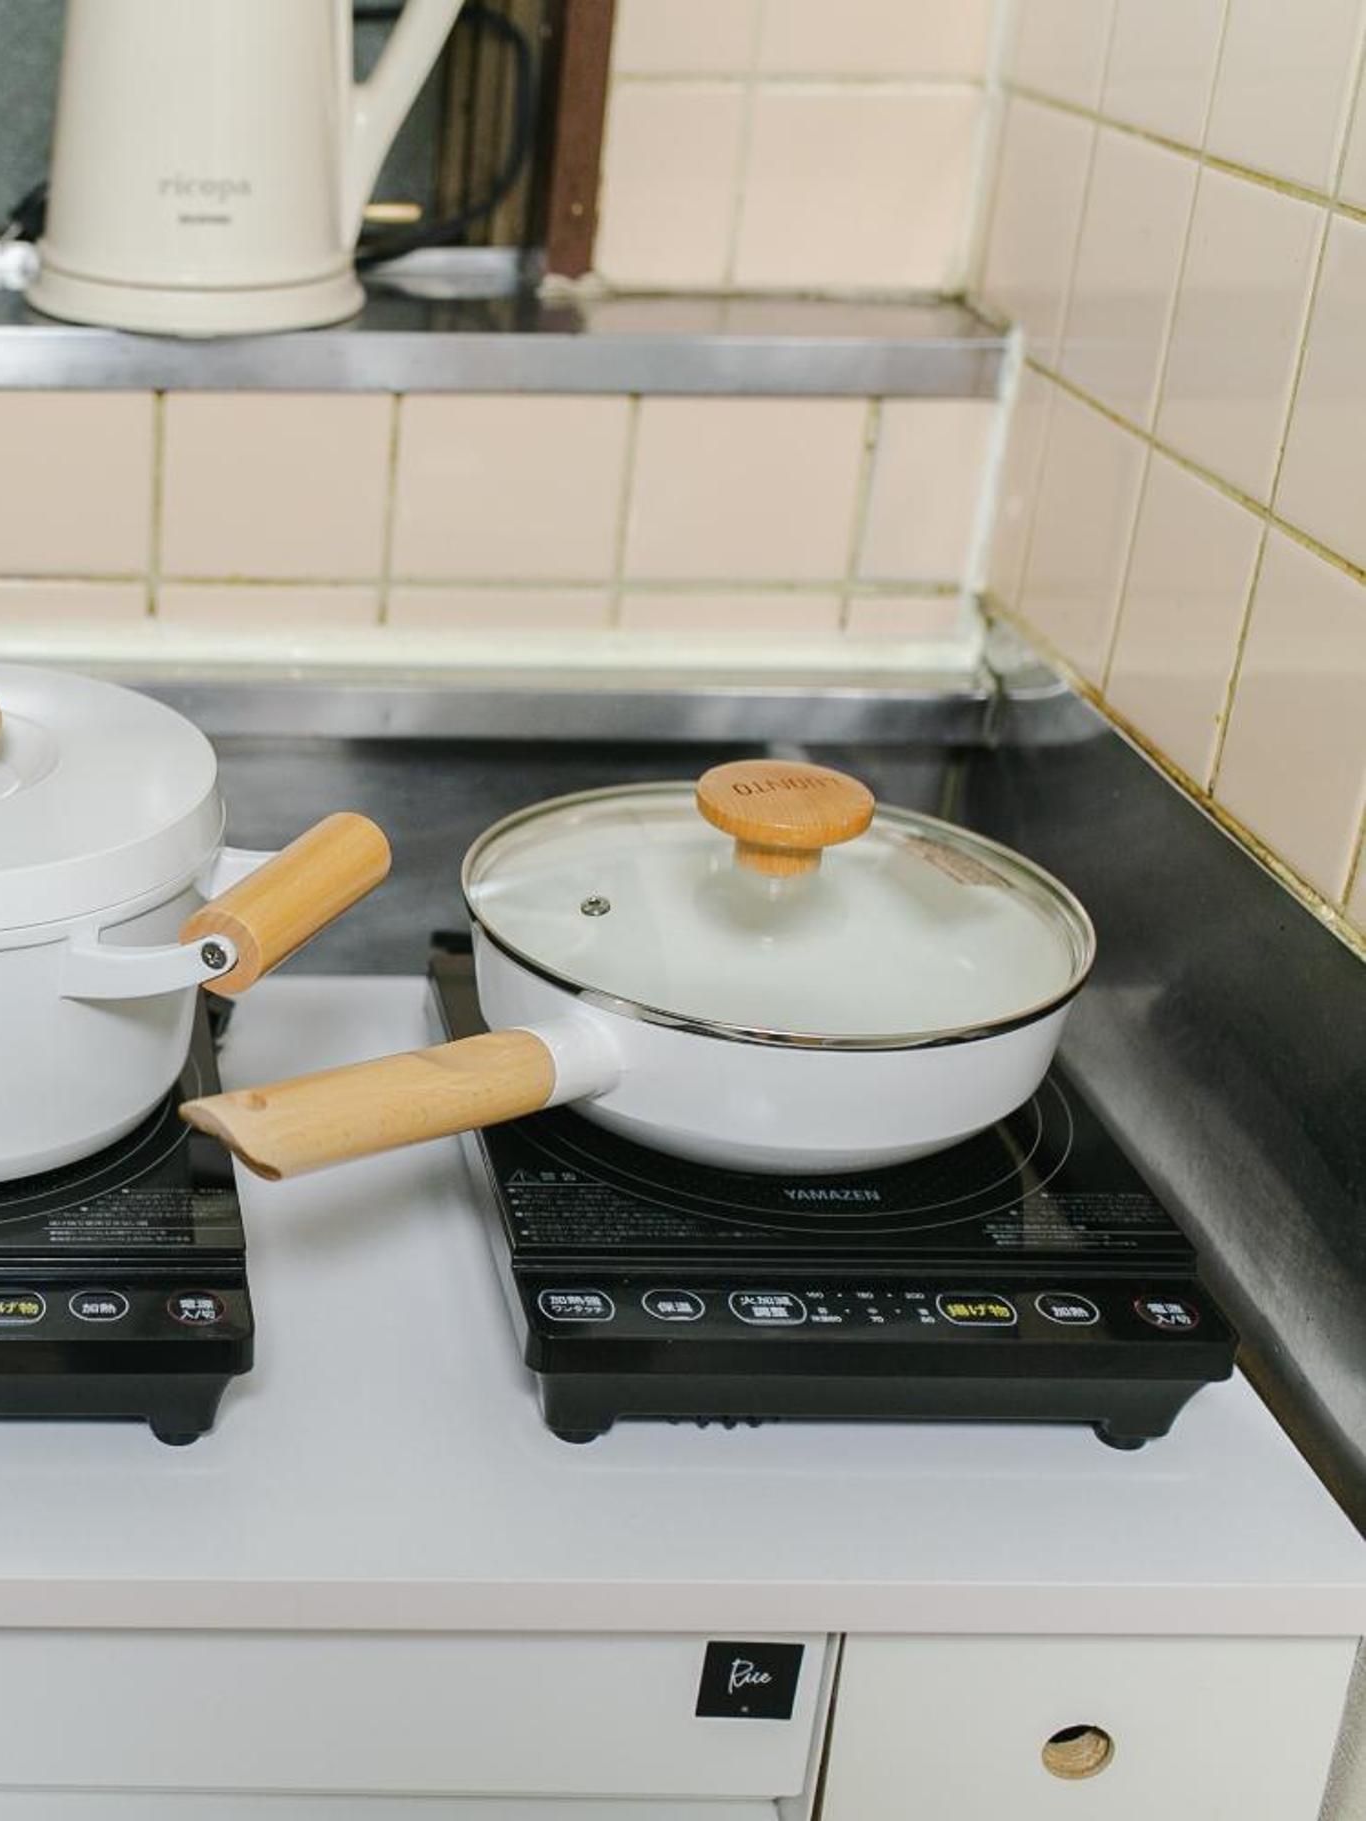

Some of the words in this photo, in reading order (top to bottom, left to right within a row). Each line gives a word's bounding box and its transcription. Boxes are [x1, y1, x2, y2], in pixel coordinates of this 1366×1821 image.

[158, 172, 253, 202] ricopa
[784, 1188, 881, 1201] YAMAZEN
[740, 1295, 793, 1306] 火加減
[727, 1657, 773, 1695] Rice
